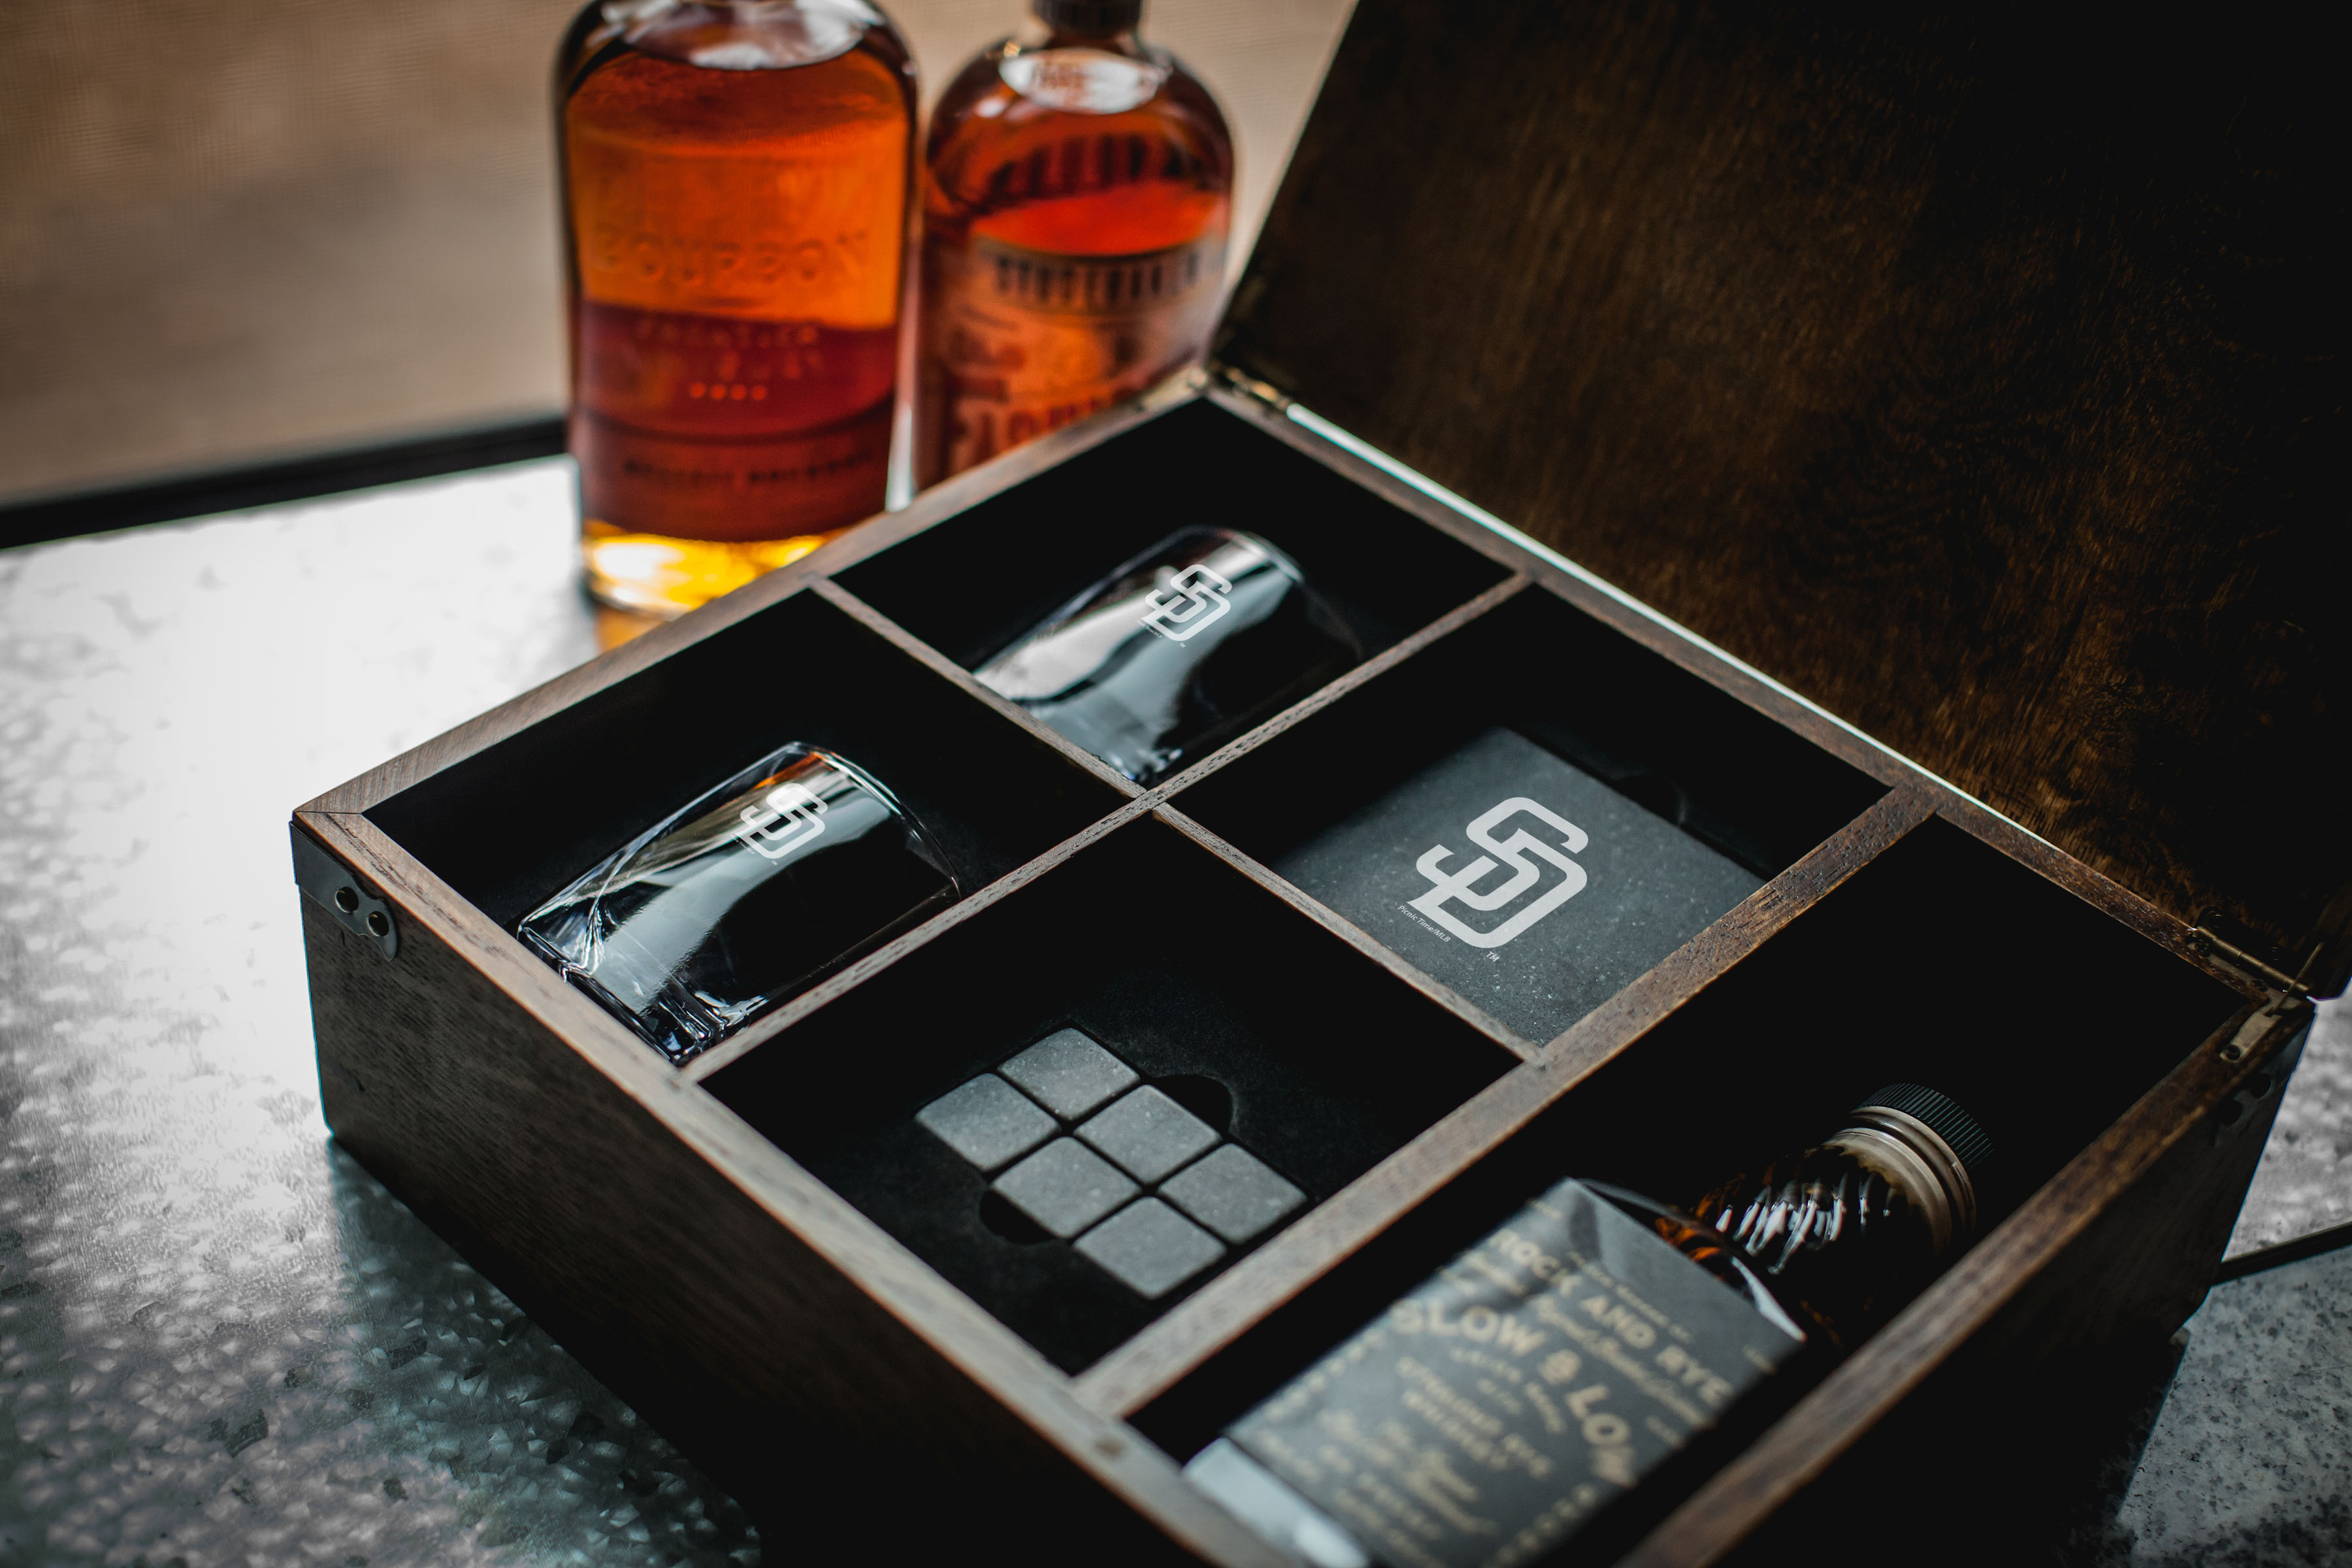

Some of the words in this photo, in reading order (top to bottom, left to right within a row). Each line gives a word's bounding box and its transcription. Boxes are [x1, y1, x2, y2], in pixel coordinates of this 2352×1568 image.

[1397, 905, 1418, 921] Picnic
[1417, 917, 1451, 942] Time/MLB
[1486, 951, 1500, 962] TM
[1581, 1296, 1656, 1350] AND
